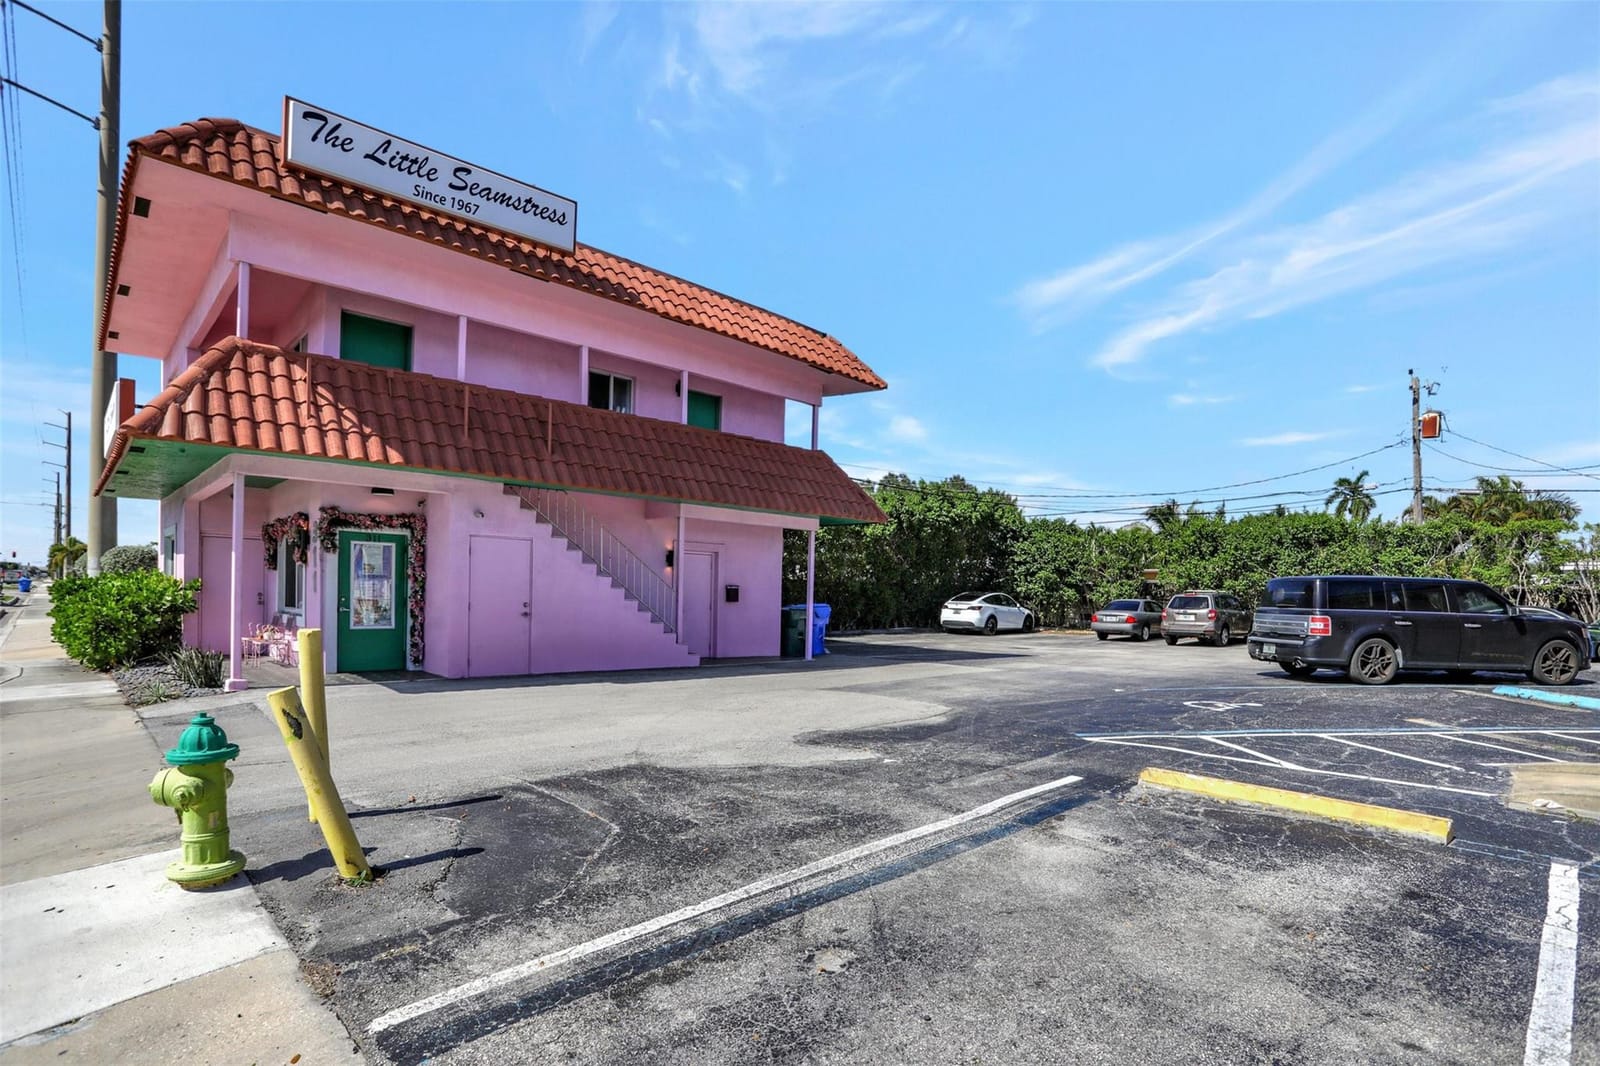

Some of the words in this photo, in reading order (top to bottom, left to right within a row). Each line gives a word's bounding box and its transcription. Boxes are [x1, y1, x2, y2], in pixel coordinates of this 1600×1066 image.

[302, 111, 354, 152] The
[363, 139, 439, 182] Little
[448, 166, 568, 226] Seamstress
[412, 184, 447, 206] Since
[450, 197, 480, 216] 1967
